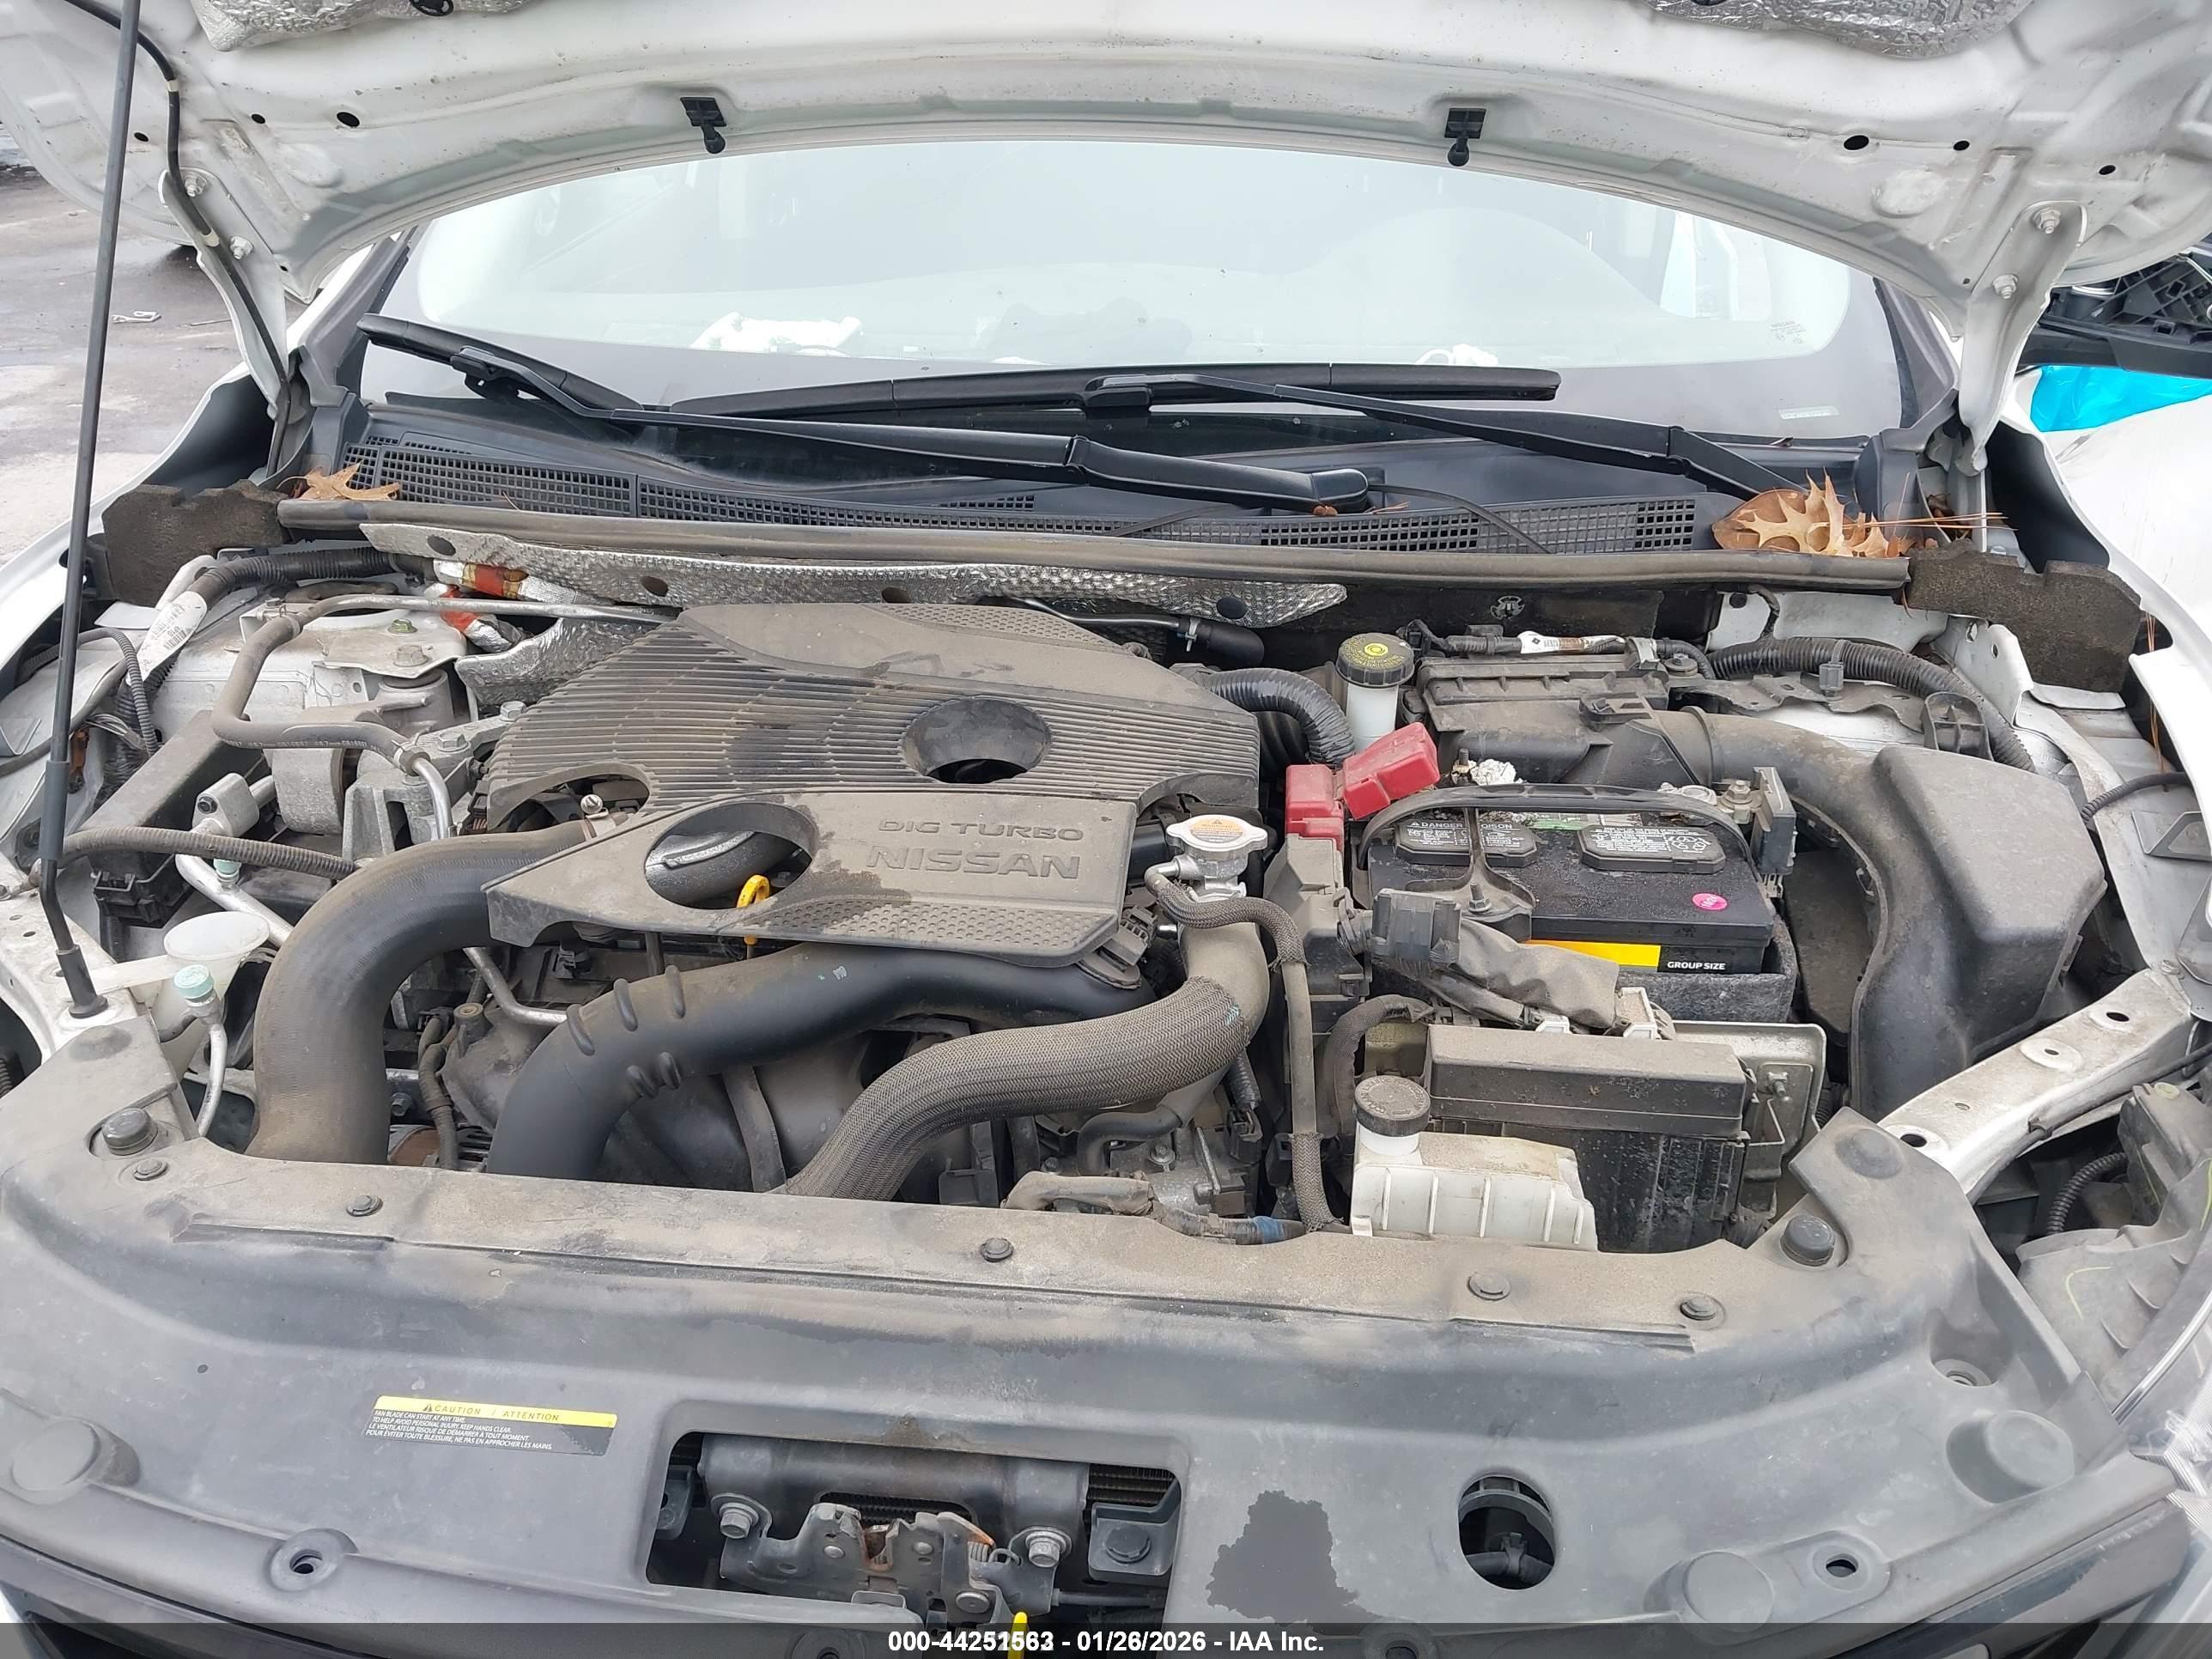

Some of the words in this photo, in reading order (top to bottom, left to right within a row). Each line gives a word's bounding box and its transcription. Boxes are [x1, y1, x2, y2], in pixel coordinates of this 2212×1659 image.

[878, 818, 941, 834] DIG
[951, 823, 1085, 842] TURBO
[866, 845, 1080, 879] NISSAN
[1667, 961, 1701, 970] GROUP
[1704, 962, 1726, 971] SIZE
[434, 1405, 481, 1415] CAUTION
[502, 1411, 560, 1421] ATTENTION
[412, 1419, 440, 1428] PERSONAL
[377, 1424, 415, 1432] VENTILATEUR
[416, 1426, 437, 1435] RISQUE
[484, 1438, 520, 1448] APPROCHER
